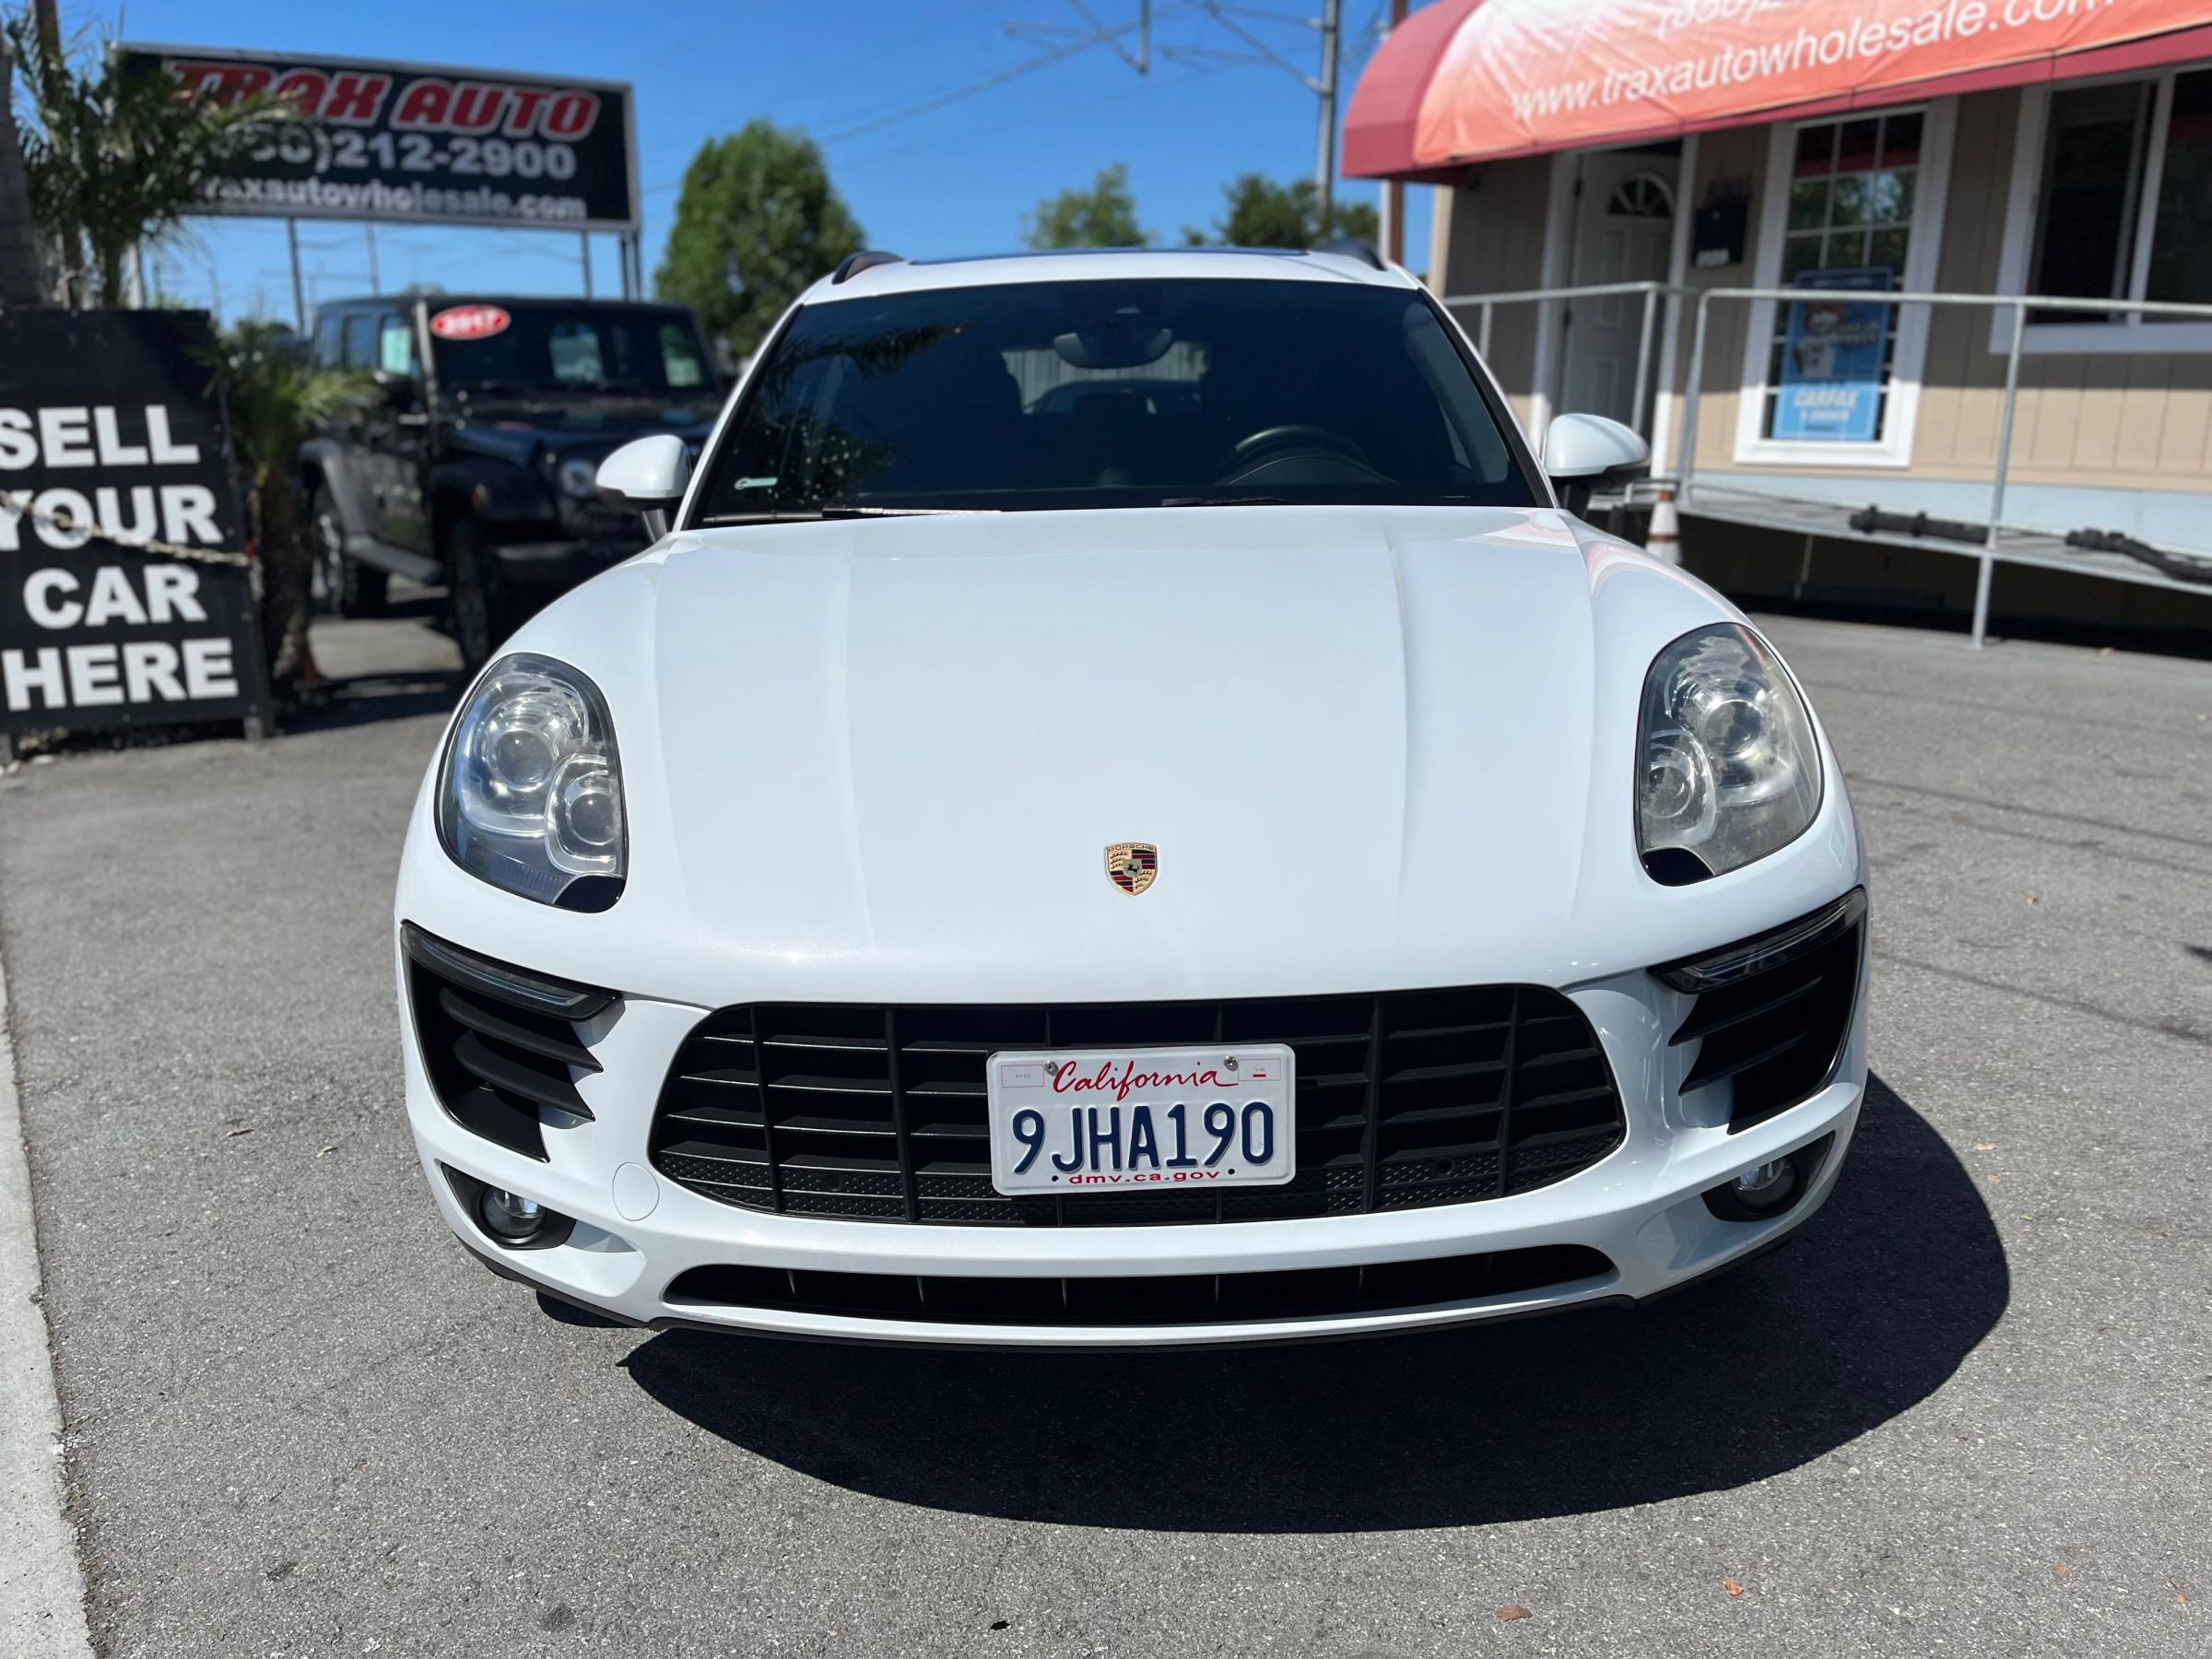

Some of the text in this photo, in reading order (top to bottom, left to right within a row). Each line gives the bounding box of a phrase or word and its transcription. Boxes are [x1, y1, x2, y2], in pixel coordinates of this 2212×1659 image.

[170, 62, 601, 142] TRAX AUTO
[199, 175, 588, 219] raxautowholesale.com
[0, 405, 200, 470] SELL
[0, 485, 224, 551] YOUR
[23, 564, 207, 629] CAR
[3, 637, 239, 712] HERE
[1053, 1060, 1239, 1102] California
[1012, 1101, 1275, 1175] 9JHA190
[1068, 1170, 1221, 1186] dmv.ca.gov
